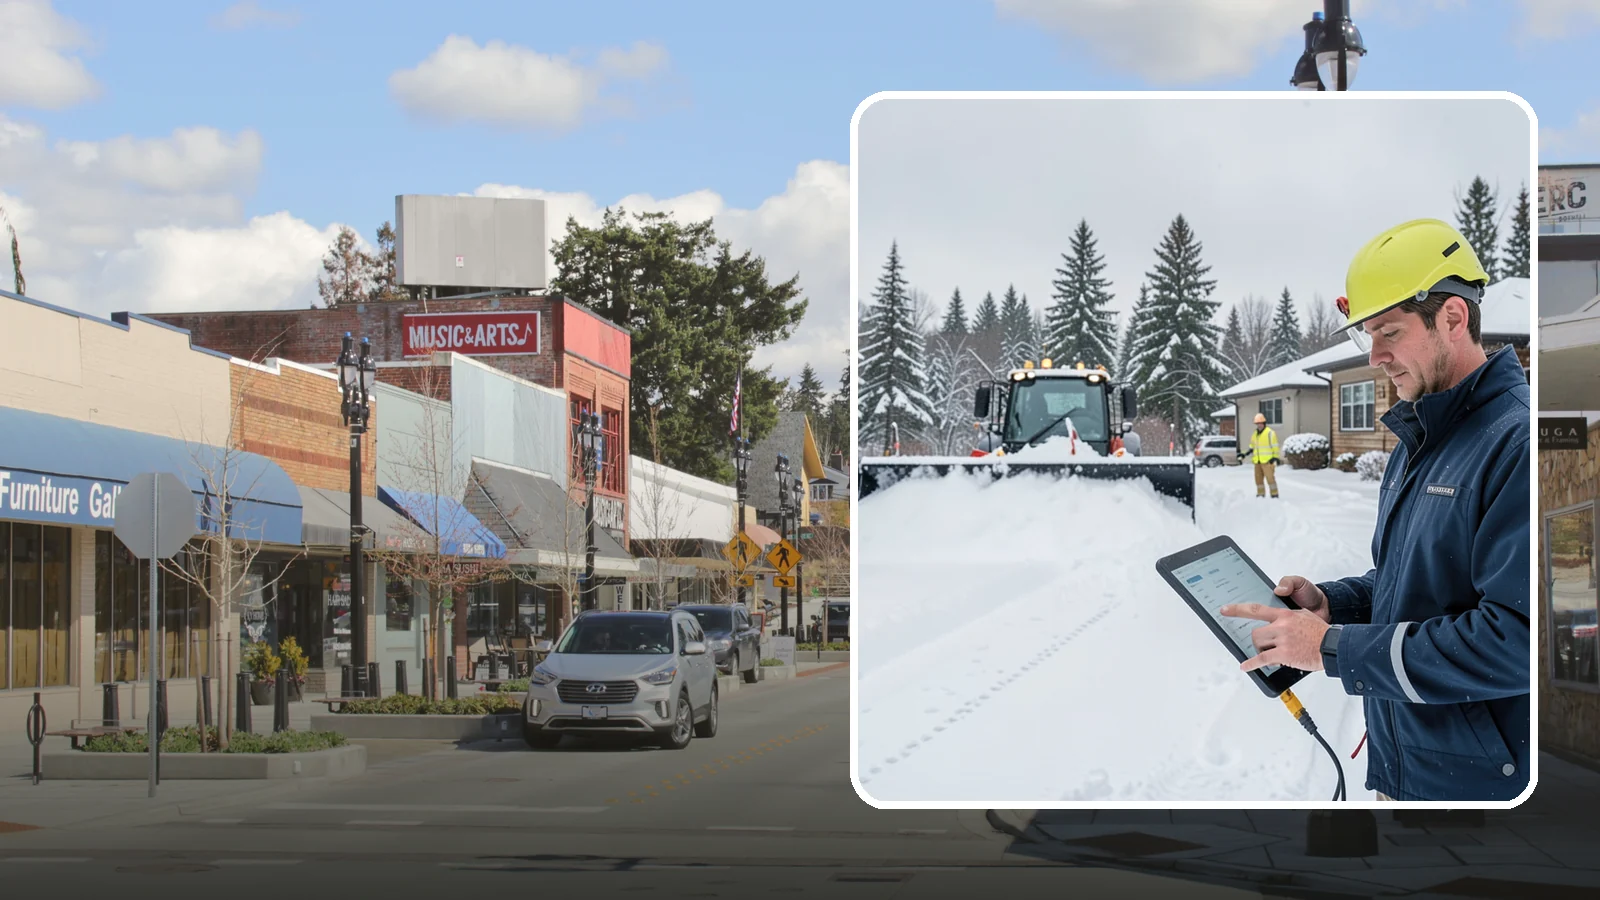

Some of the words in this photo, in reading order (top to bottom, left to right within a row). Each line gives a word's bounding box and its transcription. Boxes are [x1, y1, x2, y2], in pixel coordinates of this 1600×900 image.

[409, 323, 519, 349] MUSIC&ARTS
[0, 471, 79, 515] Furniture
[89, 482, 121, 519] Gal
